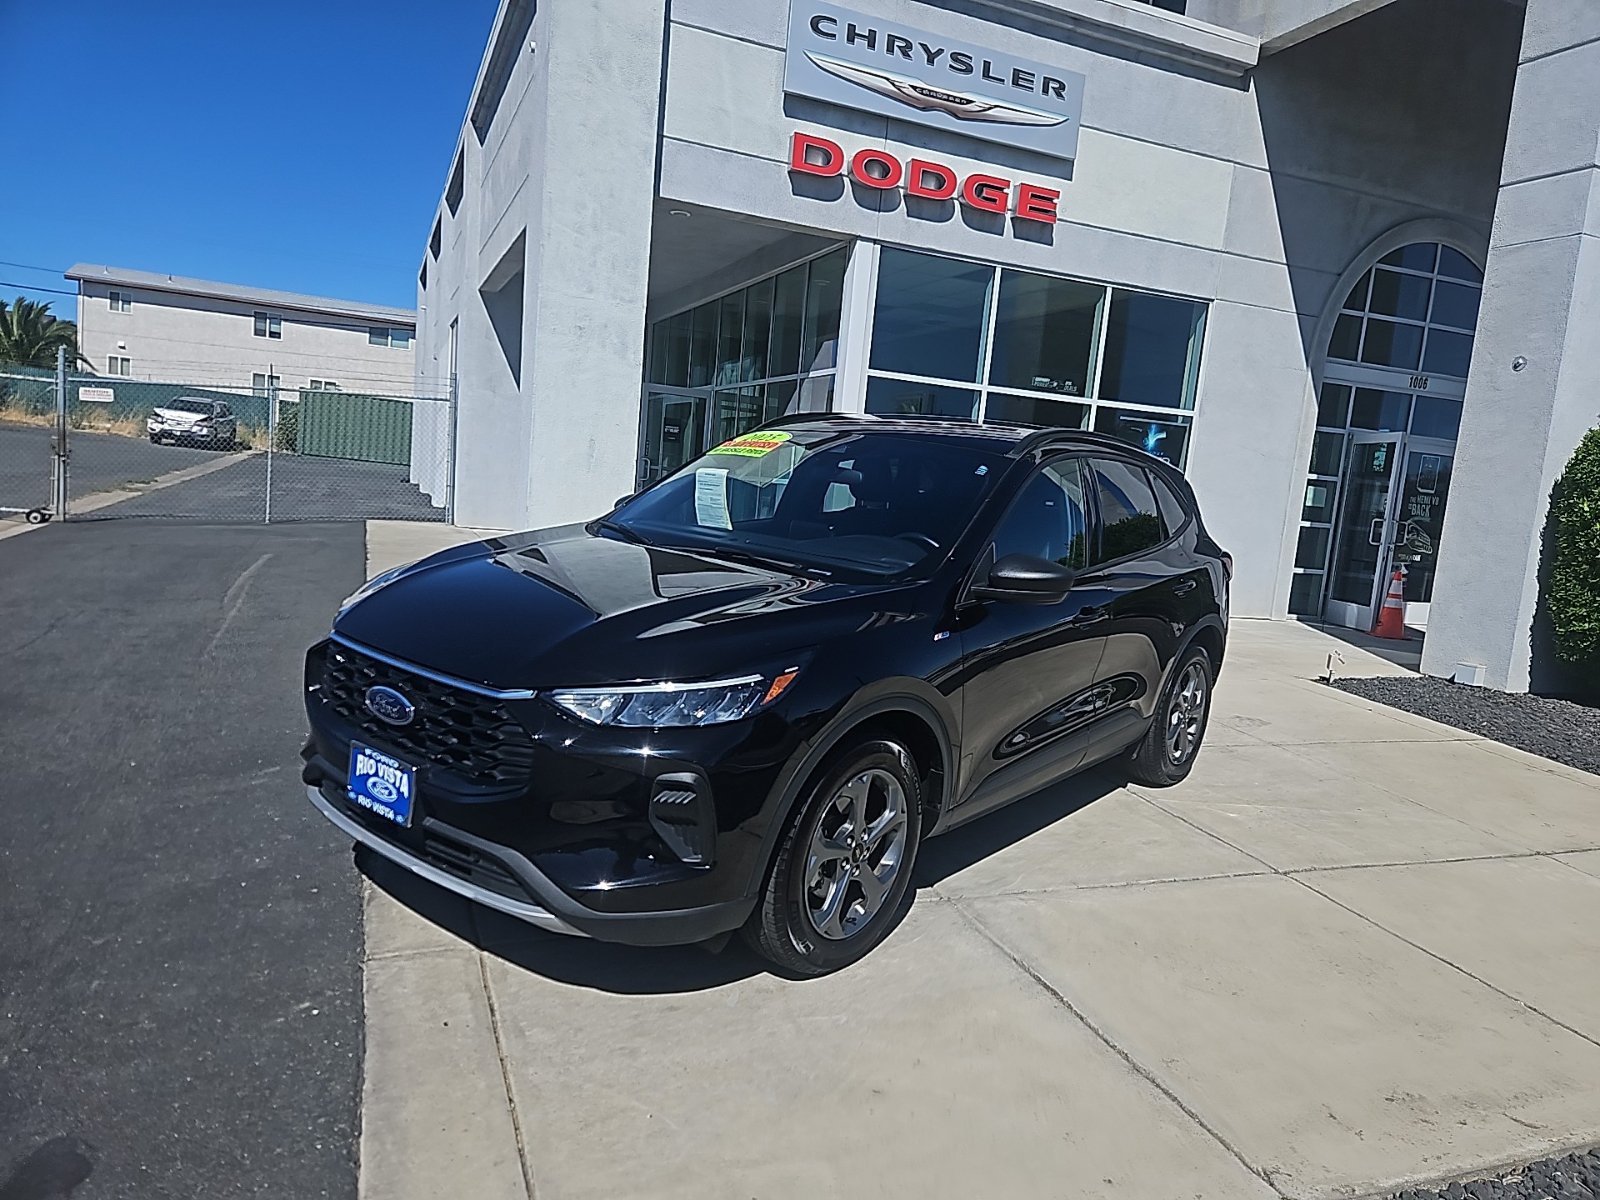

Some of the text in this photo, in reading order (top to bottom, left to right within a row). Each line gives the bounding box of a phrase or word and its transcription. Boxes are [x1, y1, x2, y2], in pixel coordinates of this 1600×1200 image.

[809, 15, 1067, 101] CHRYSLER
[790, 132, 1060, 224] DODGE
[1408, 375, 1428, 390] 1006
[1411, 503, 1431, 517] BACK
[356, 753, 409, 799] RIO VISTA
[358, 794, 395, 821] RIO VISTA
